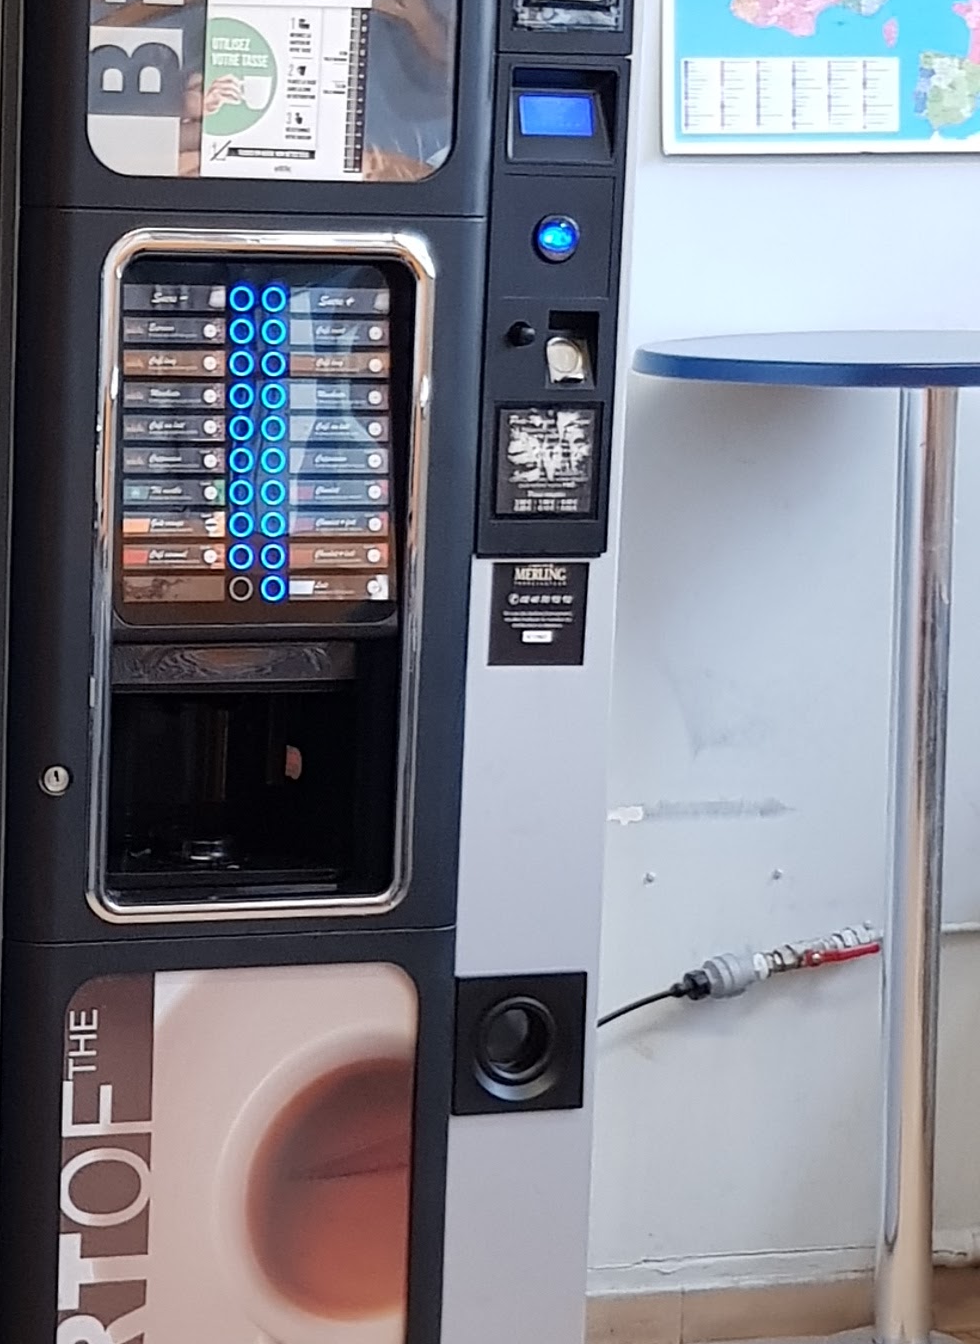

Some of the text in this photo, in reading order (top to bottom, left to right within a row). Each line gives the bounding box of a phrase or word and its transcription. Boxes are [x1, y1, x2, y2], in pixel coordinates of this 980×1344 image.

[211, 38, 250, 51] UTILISEZ
[211, 54, 268, 67] VOTRE TASSE
[67, 1008, 100, 1078] THE
